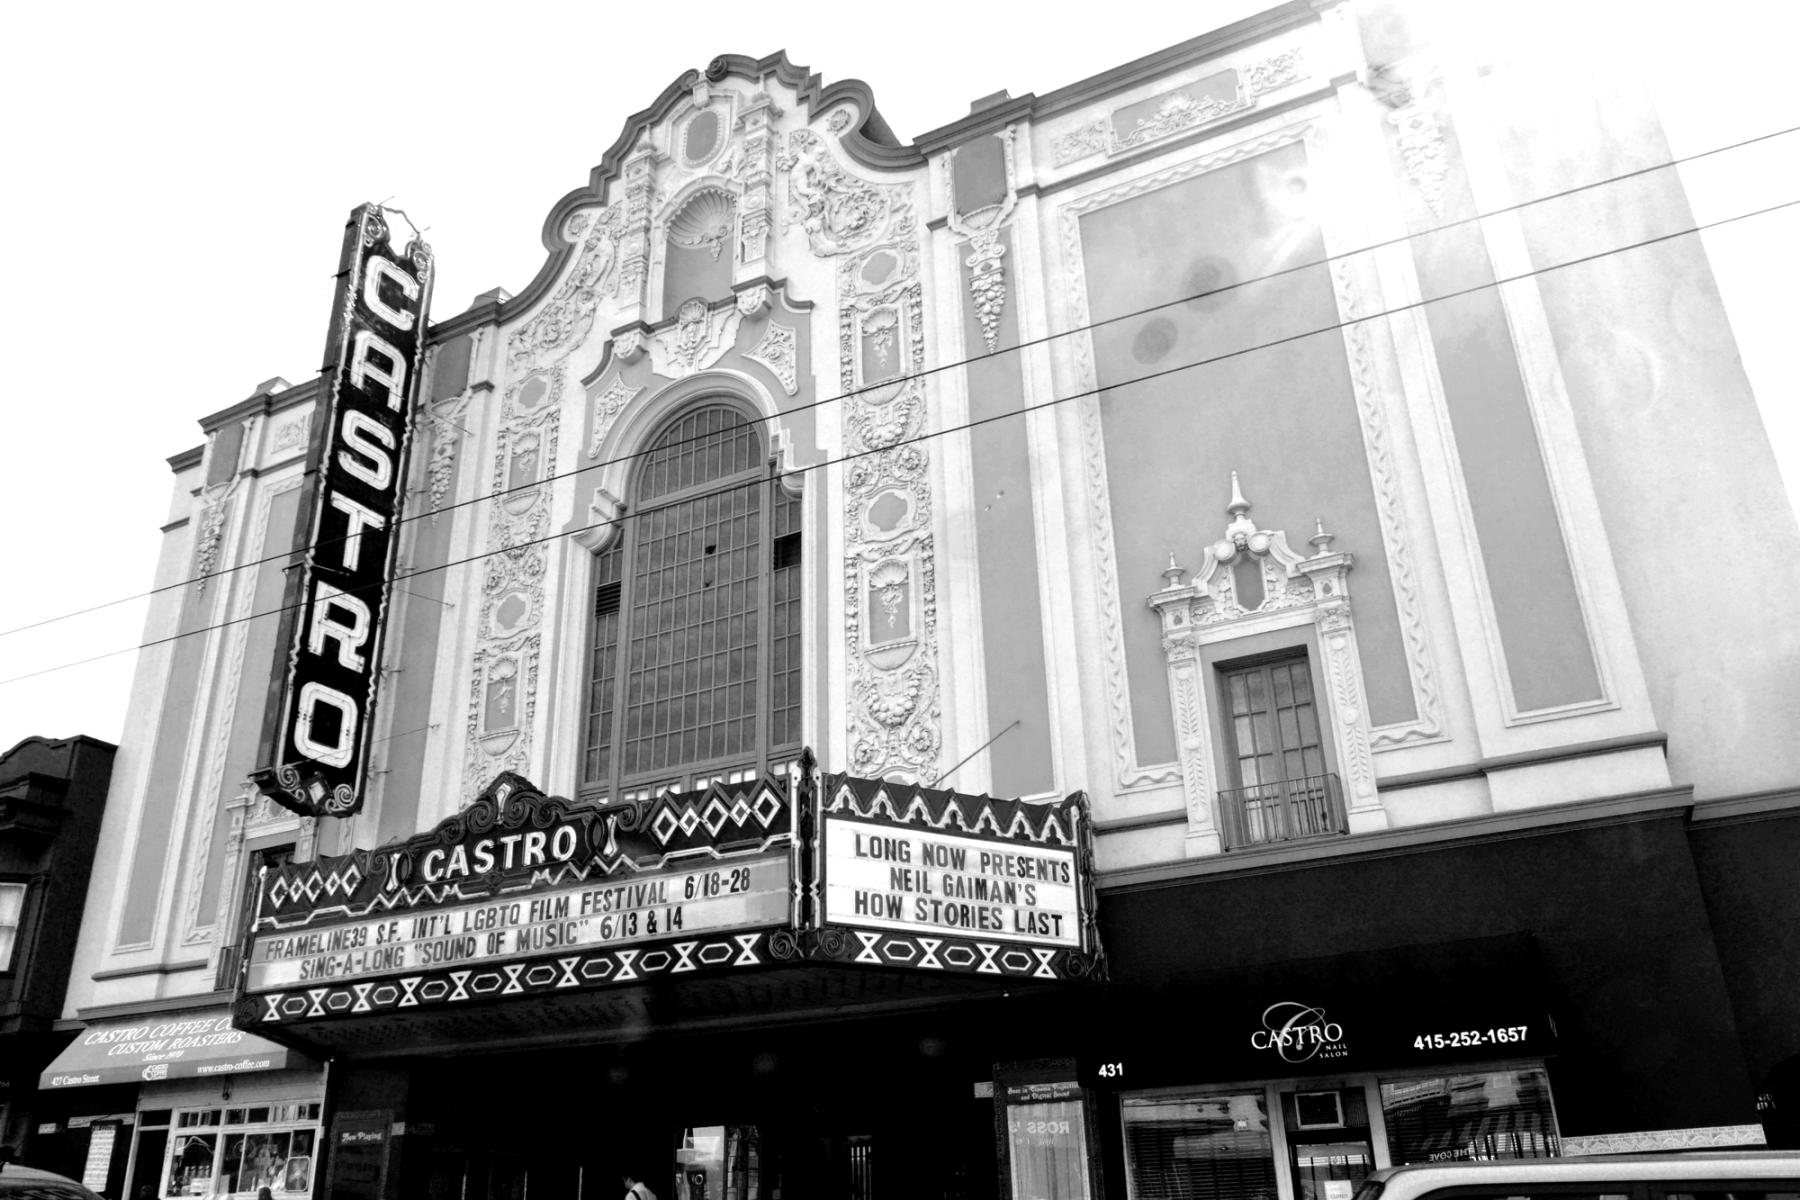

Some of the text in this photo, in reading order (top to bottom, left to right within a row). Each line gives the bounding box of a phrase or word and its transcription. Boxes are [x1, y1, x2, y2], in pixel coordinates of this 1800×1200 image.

[293, 254, 420, 770] CASTRO
[421, 825, 577, 882] CASTRO
[855, 833, 1070, 883] LONG NOW PRESENTS
[890, 867, 1036, 906] NEIL GAIMAN'S
[265, 867, 751, 960] FRAMELINE39 S.F. INT'L LGBTQ FILM FESTIVAL 6/18-28
[854, 890, 1063, 937] HOW STORIES LAST
[300, 946, 405, 980] SING-A-LONG
[486, 932, 506, 955] OF
[600, 912, 637, 939] 6/13
[646, 910, 657, 933] &
[666, 906, 683, 931] 14
[84, 1026, 149, 1045] CASTRO
[149, 1019, 216, 1038] COFFEE
[108, 1038, 170, 1056] CUSTOM
[168, 1032, 246, 1049] ROASTERS
[1251, 1022, 1343, 1050] CASTRO
[1325, 1043, 1347, 1051] NAIL
[1413, 1025, 1528, 1051] 415-252-1657
[1098, 1063, 1124, 1078] 431
[1319, 1051, 1348, 1059] SALON
